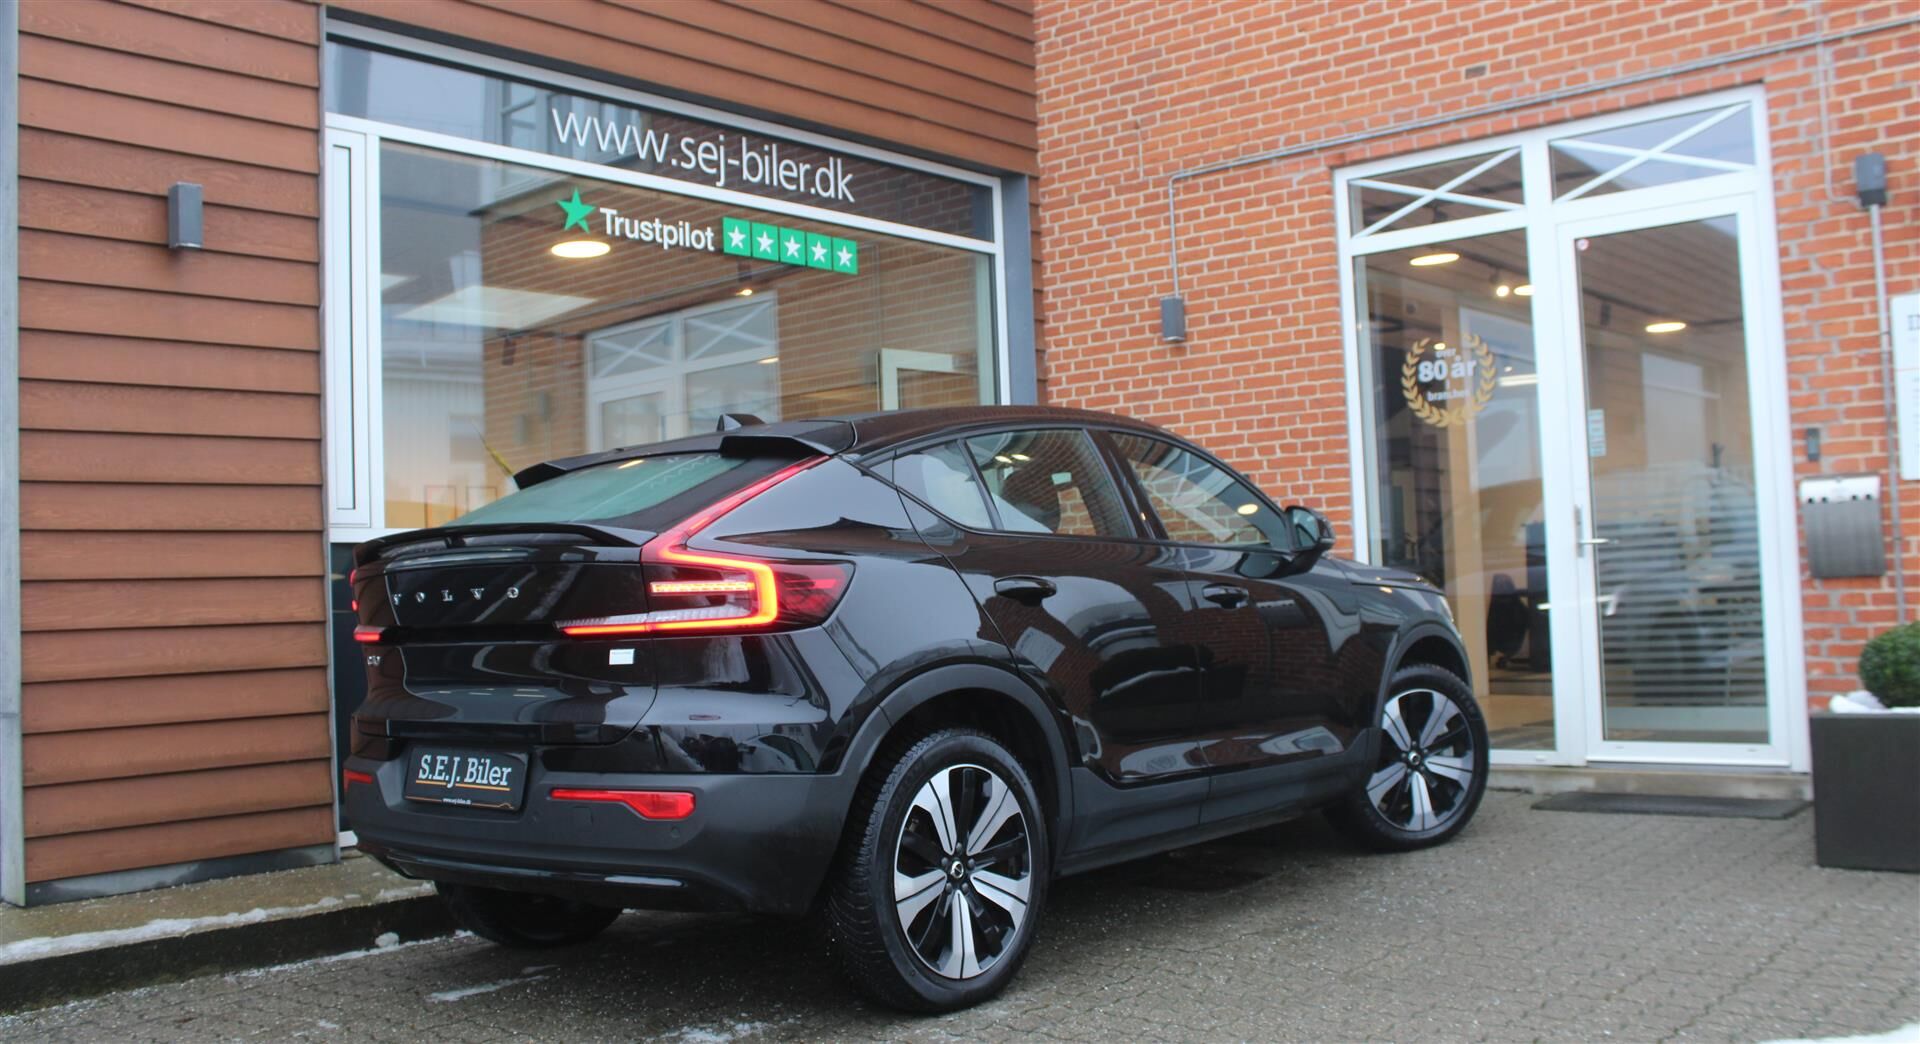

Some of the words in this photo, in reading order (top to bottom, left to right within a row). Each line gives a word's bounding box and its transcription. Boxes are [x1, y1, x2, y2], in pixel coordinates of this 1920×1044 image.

[552, 108, 855, 202] www.sej-biler.dk
[600, 207, 715, 251] Trustpilot
[1418, 360, 1448, 382] 80
[1451, 355, 1476, 378] år
[393, 586, 519, 605] VOLVO
[418, 754, 461, 788] S.E.J.
[464, 757, 512, 786] Biler
